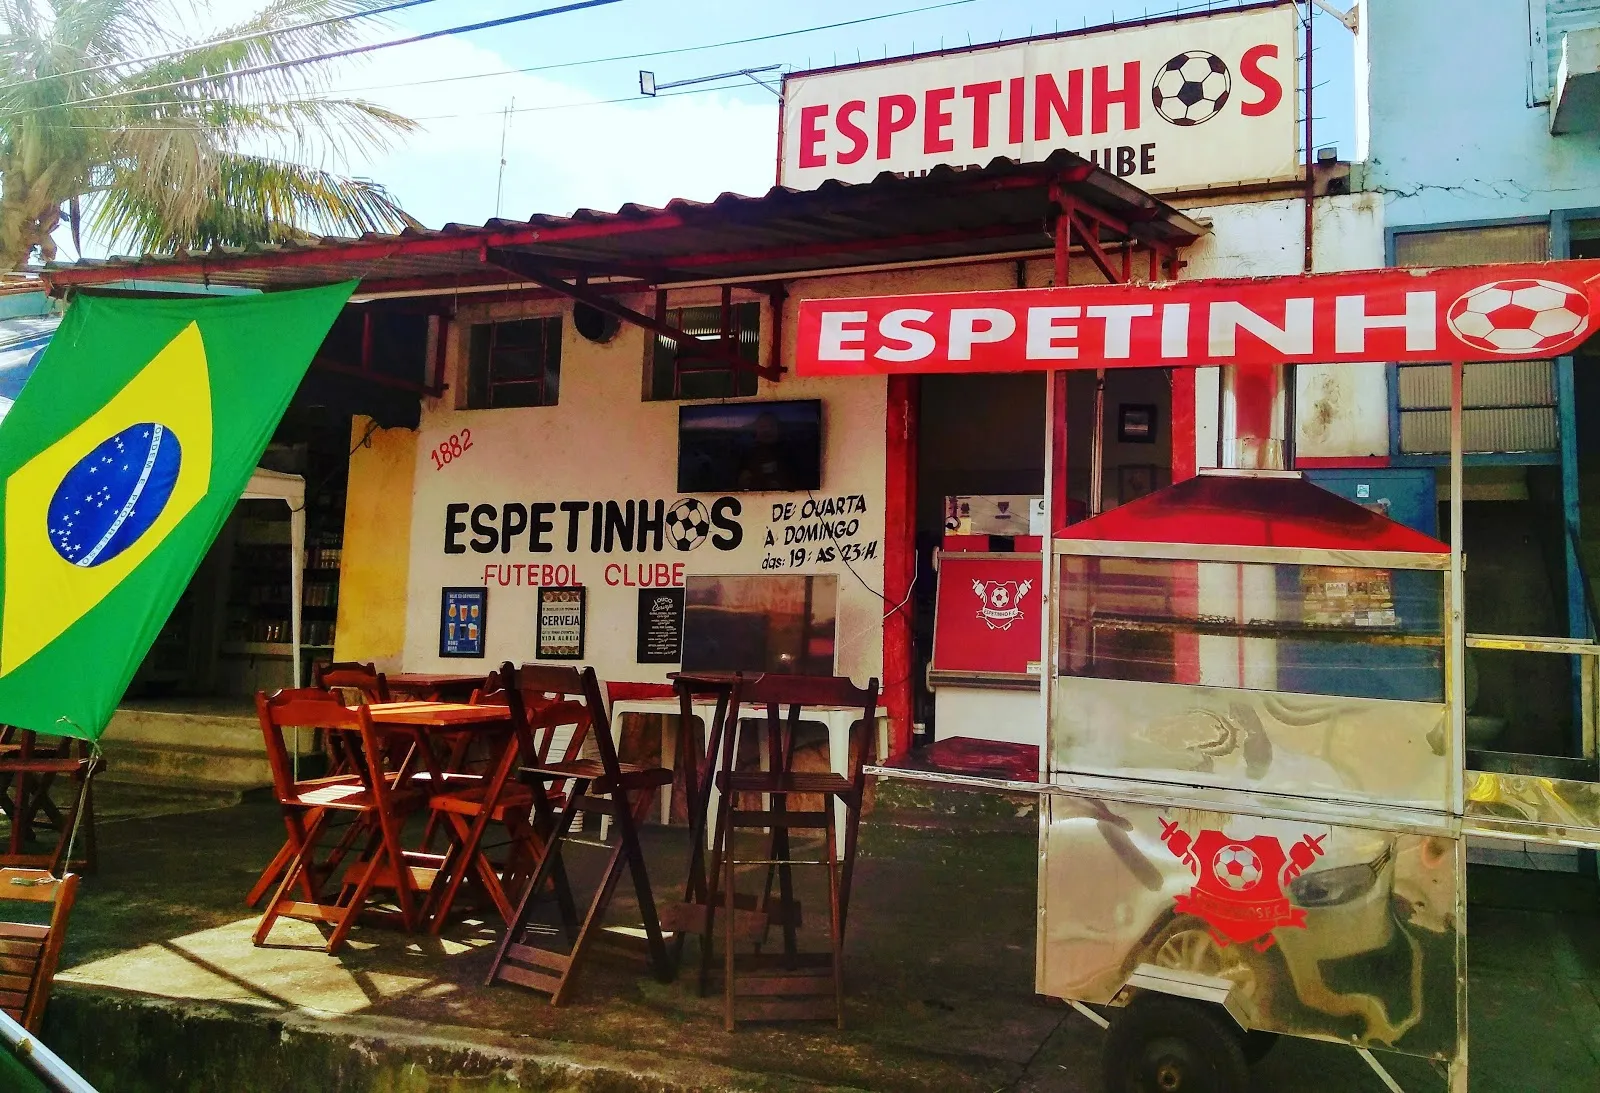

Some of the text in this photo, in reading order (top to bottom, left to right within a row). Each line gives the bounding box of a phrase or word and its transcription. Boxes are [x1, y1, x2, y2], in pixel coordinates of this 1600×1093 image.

[146, 426, 162, 470] ORDEM
[431, 428, 474, 471] 1882
[82, 494, 138, 565] PROGRESSO
[784, 519, 859, 545] DOMINGO
[484, 562, 686, 587] FUTEBOL CLUBE
[542, 615, 580, 626] CERVEJA
